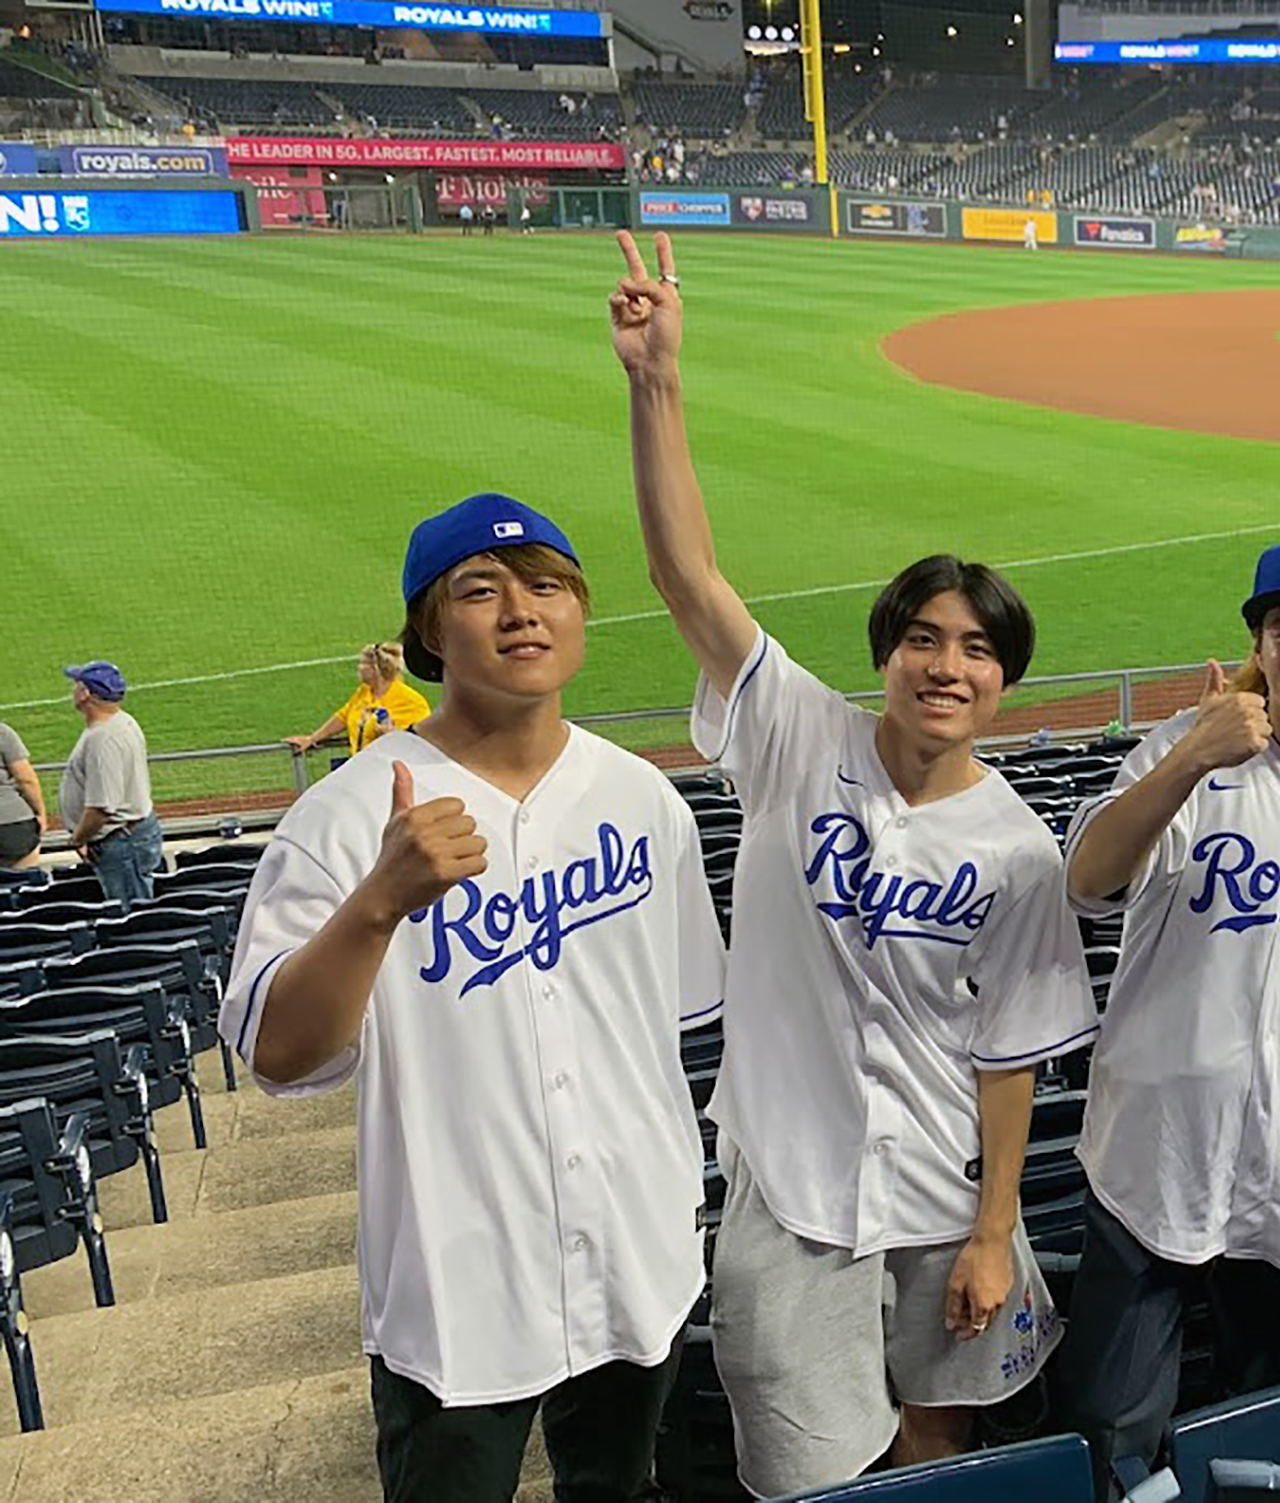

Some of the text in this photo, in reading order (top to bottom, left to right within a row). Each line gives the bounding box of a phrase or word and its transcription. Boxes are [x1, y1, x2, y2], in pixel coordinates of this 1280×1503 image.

[394, 6, 485, 26] ROYALS
[80, 151, 205, 173] royals.com
[252, 144, 313, 159] LEADER
[316, 145, 333, 159] IN
[364, 146, 434, 161] LARGEST.
[436, 147, 500, 162] FASTEST.
[502, 147, 541, 162] MOST
[410, 822, 652, 999] Royals
